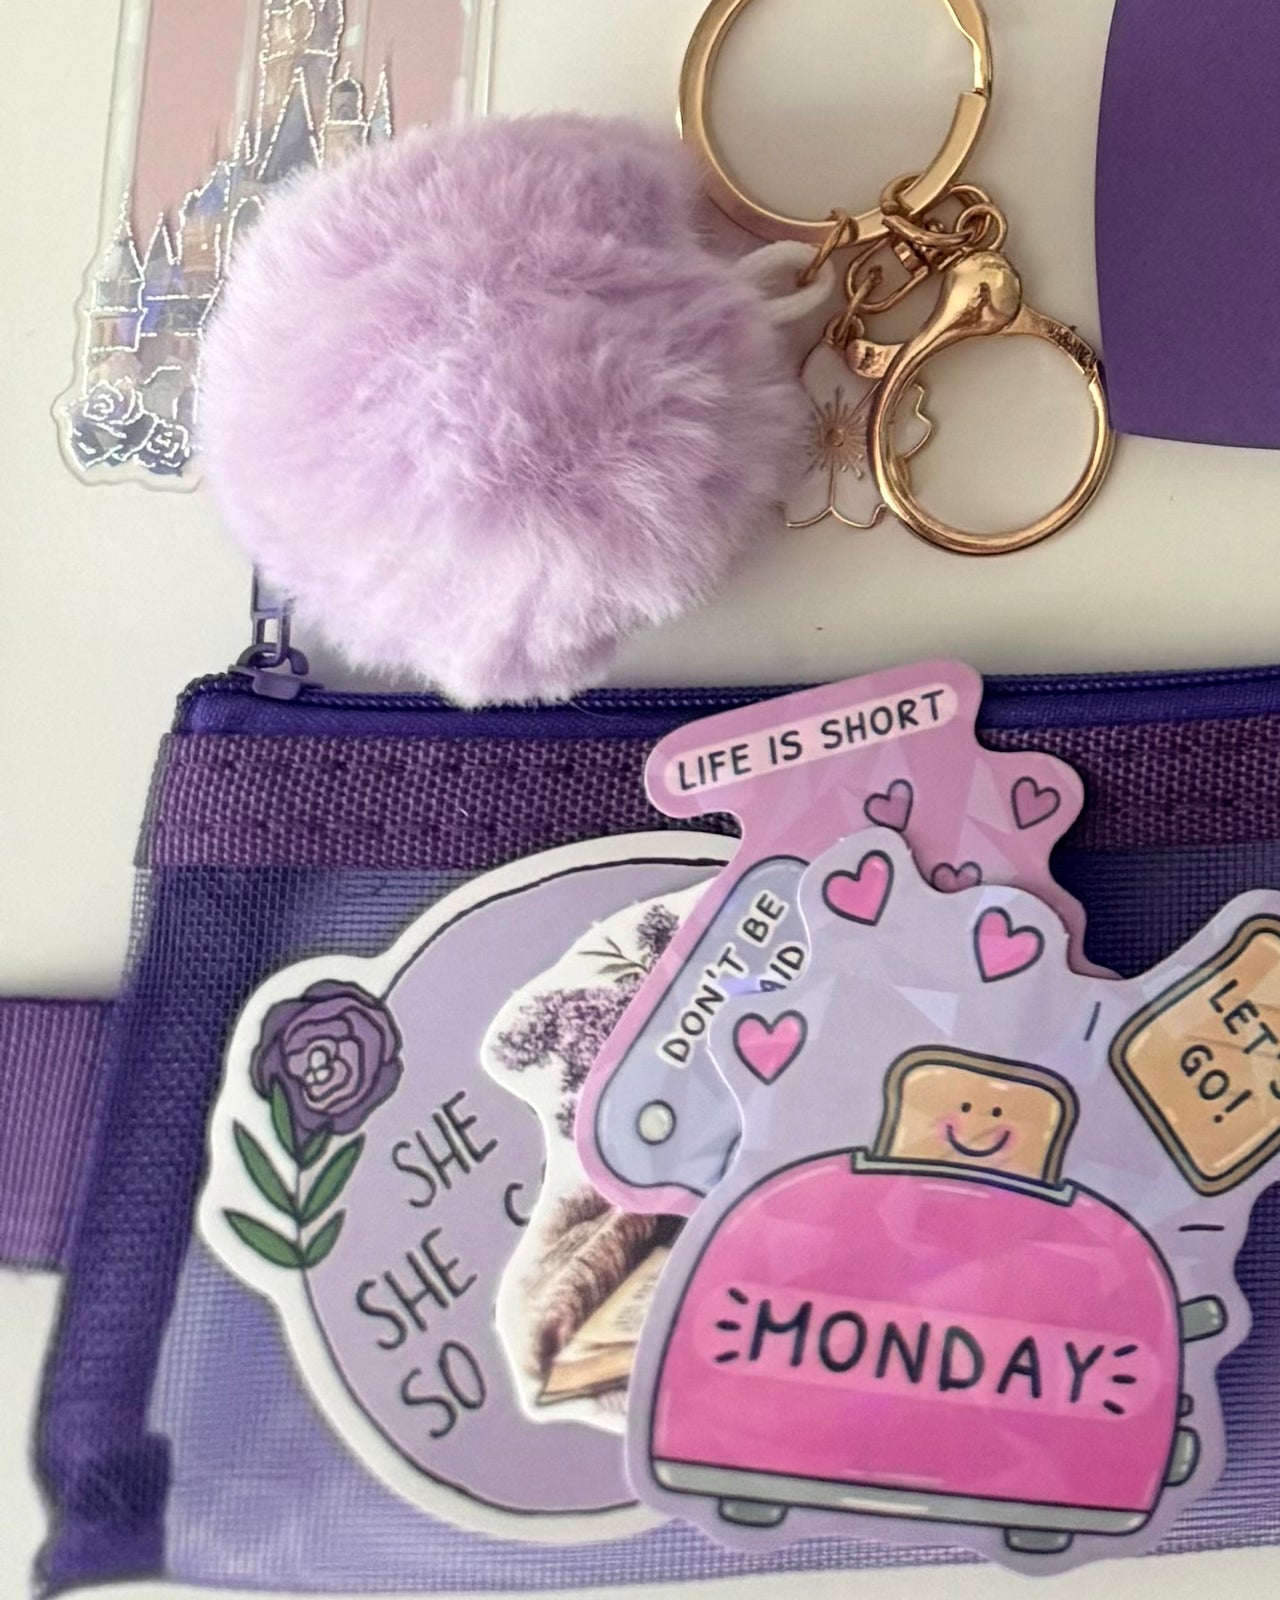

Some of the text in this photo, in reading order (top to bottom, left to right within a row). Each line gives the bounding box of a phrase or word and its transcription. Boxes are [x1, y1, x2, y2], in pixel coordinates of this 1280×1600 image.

[675, 688, 949, 794] LIFE IS SHORT
[662, 893, 786, 1063] DON'T BE
[1178, 1041, 1254, 1126] GO!
[390, 1088, 500, 1212] SHE
[353, 1228, 478, 1353] SHE
[400, 1339, 489, 1439] SO
[749, 1297, 1107, 1405] MONDAY
